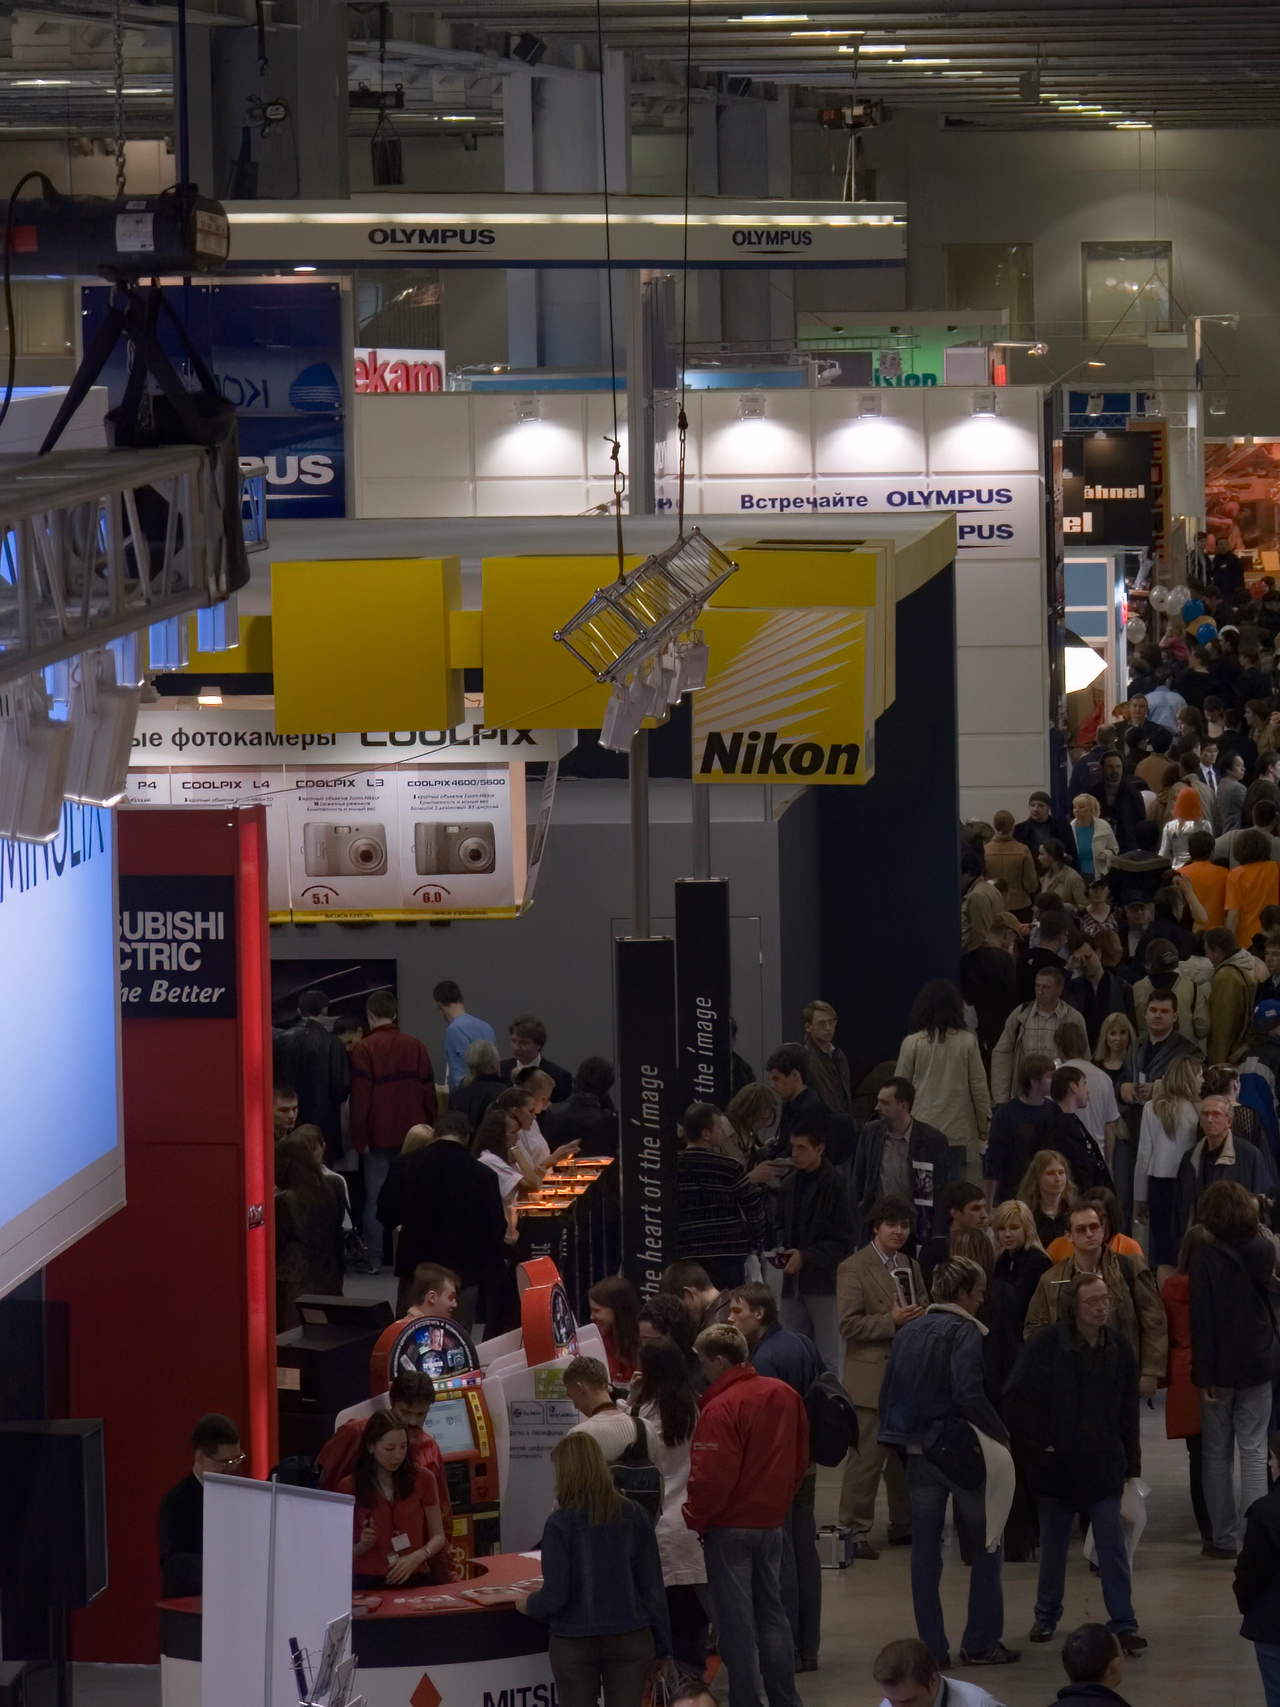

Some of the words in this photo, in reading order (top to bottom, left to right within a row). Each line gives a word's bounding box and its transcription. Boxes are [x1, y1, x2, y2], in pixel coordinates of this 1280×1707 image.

[368, 228, 496, 245] OLYMPUS
[732, 230, 812, 246] OLYMPUS
[354, 351, 442, 392] ekam
[741, 493, 869, 512] Встречайте
[886, 488, 1013, 507] OLYMPUS
[171, 728, 337, 754] фотокамеры
[700, 731, 860, 775] Nikon
[138, 781, 157, 789] P4
[182, 781, 242, 790] COOLPIX
[253, 780, 270, 789] L4
[296, 779, 356, 788] COOLPIX
[366, 779, 384, 787] L3
[407, 780, 450, 788] COOLPIX
[312, 893, 330, 904] 5.1
[423, 892, 442, 903] 6.0
[150, 979, 225, 1003] Better
[693, 1063, 714, 1093] the
[638, 1137, 661, 1169] the
[638, 1175, 662, 1198] of
[636, 1204, 662, 1262] heart
[640, 1270, 662, 1302] the
